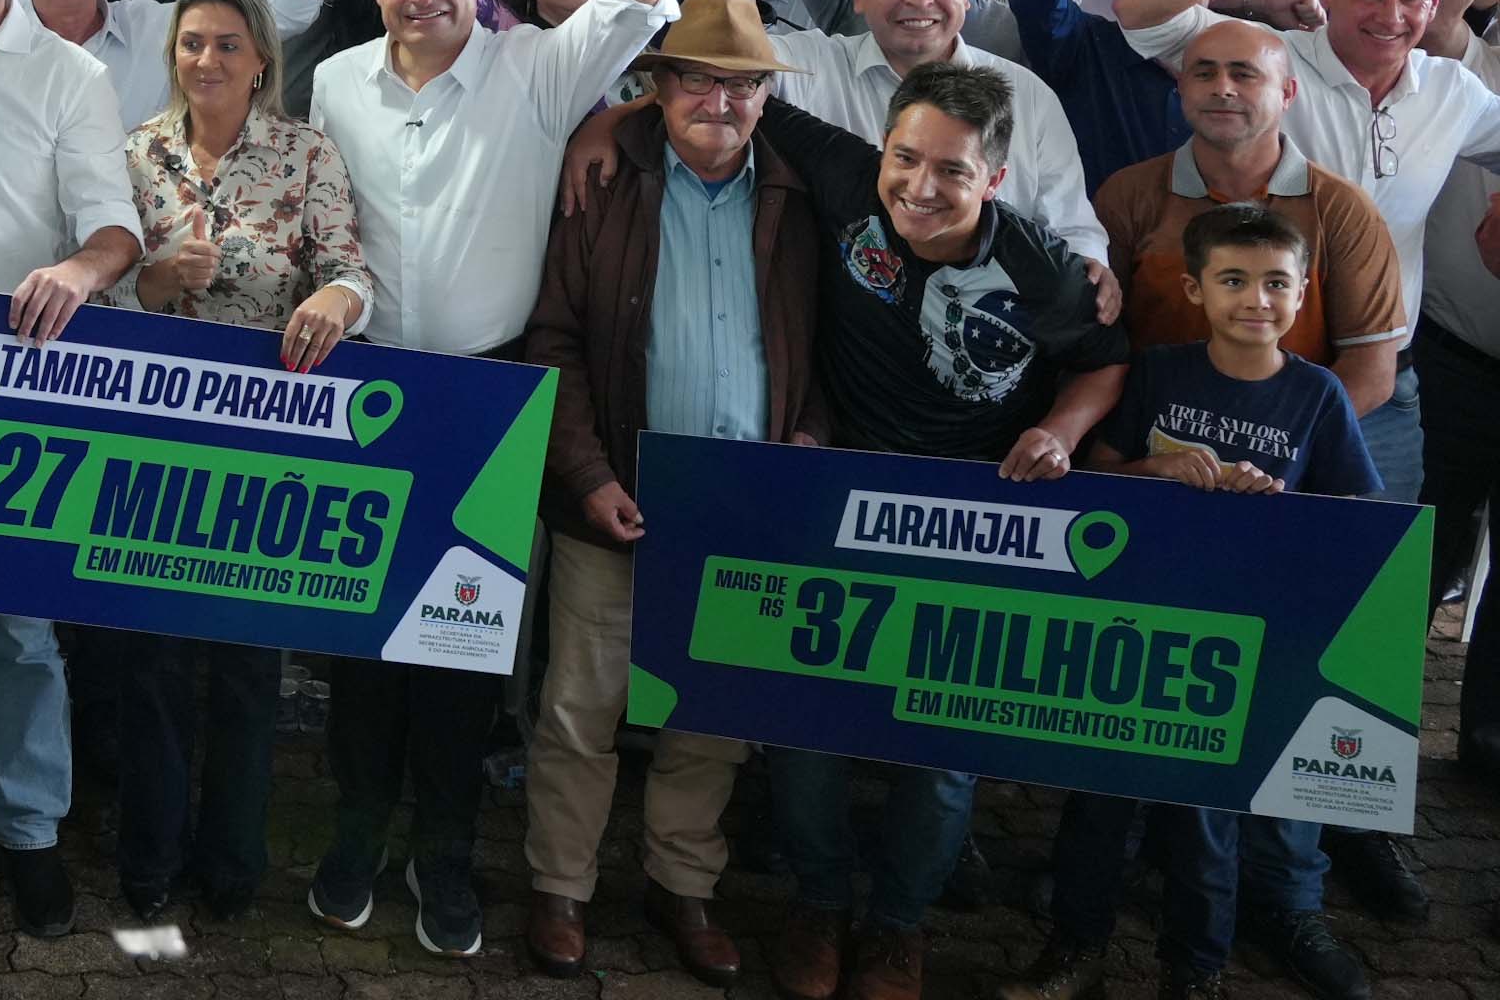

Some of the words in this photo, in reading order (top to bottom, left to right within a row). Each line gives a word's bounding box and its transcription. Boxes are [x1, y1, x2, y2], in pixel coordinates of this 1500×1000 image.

[138, 363, 190, 408] DO
[193, 370, 335, 428] PARANÁ
[1156, 414, 1238, 446] NAUTICAL
[1248, 435, 1299, 462] TEAM
[1168, 403, 1214, 425] TRUE
[1219, 415, 1291, 445] SAILORS
[91, 458, 388, 568] MILHÕES
[854, 500, 1044, 559] LARANJAL
[86, 546, 122, 572] EM
[123, 551, 293, 593] INVESTIMENTOS
[298, 572, 369, 602] TOTAIS
[715, 569, 762, 591] MAIS
[765, 575, 788, 595] DE
[421, 604, 504, 627] PARANÁ
[759, 597, 784, 618] R$
[790, 578, 896, 671] 37
[906, 603, 1240, 716] MILHÕES
[906, 689, 942, 715] EM
[946, 694, 1136, 741] INVESTIMENTOS
[1144, 720, 1226, 753] TOTAIS
[1293, 757, 1396, 783] PARANÁ
